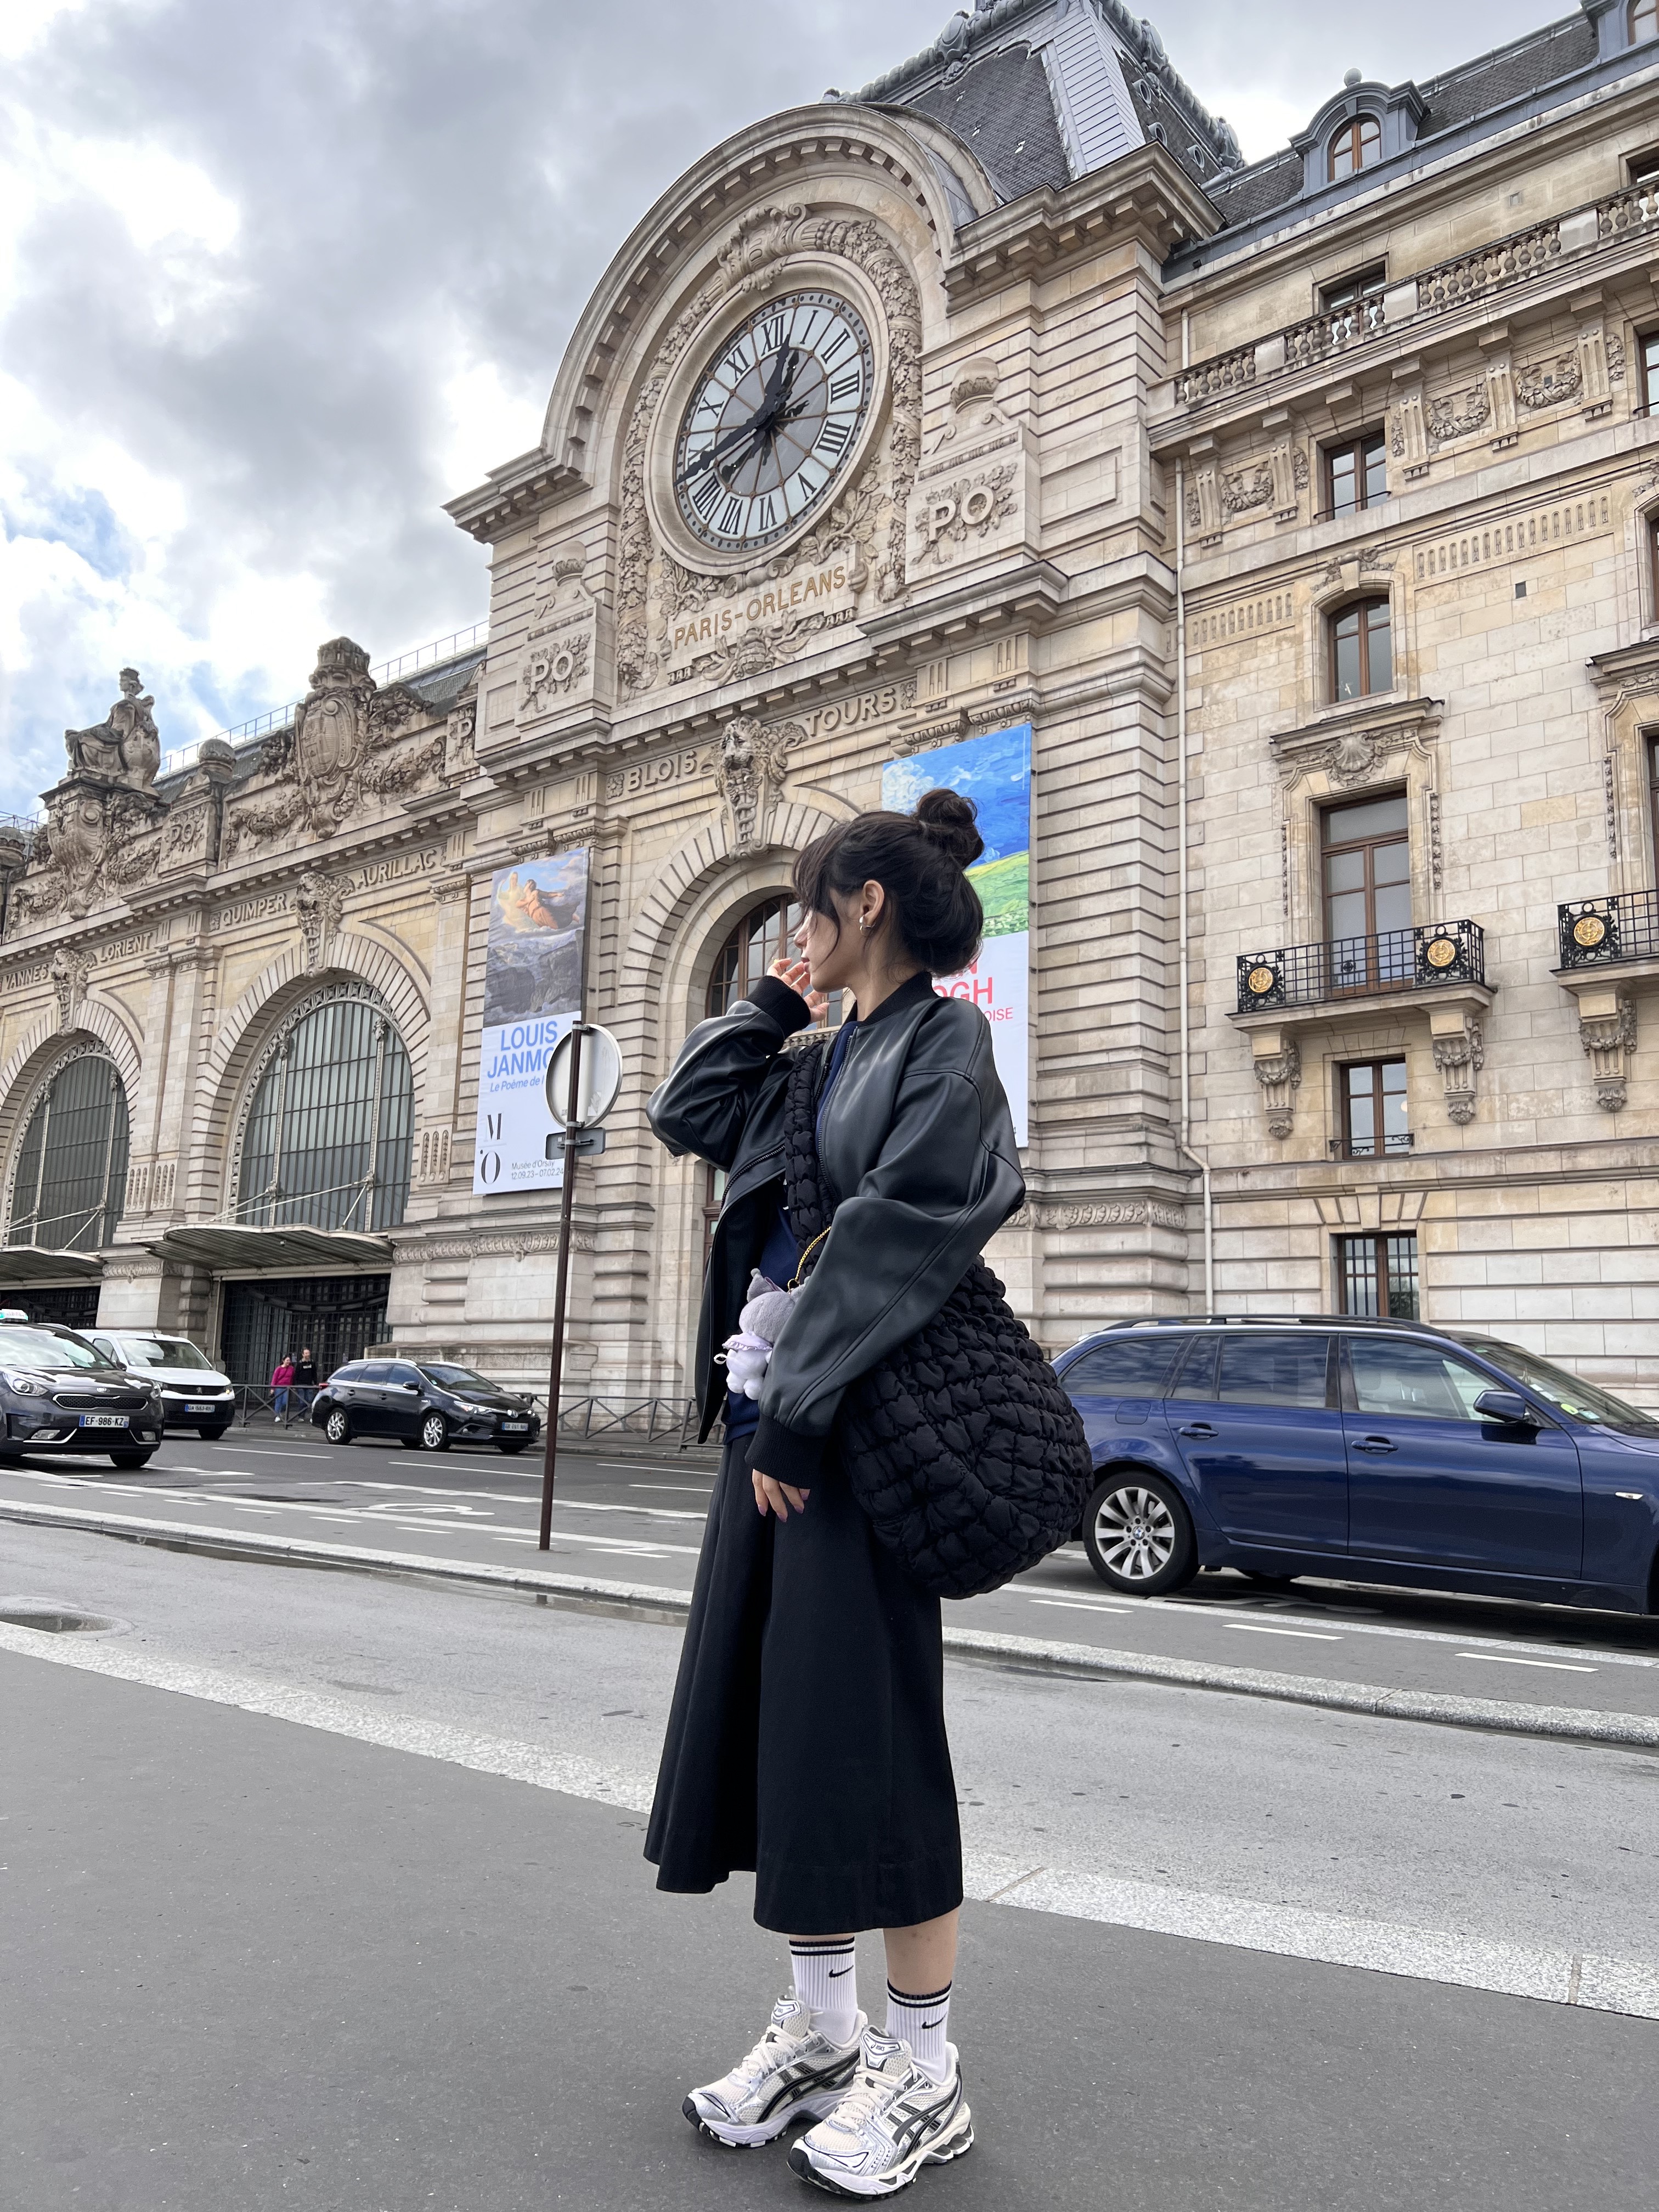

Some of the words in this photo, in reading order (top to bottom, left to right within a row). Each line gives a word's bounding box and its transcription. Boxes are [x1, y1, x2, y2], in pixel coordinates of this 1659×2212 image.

[761, 313, 786, 357] XII
[821, 328, 850, 364] II
[724, 345, 751, 383] XI
[831, 370, 859, 404] III
[697, 397, 724, 418] X
[815, 420, 851, 456] IIII
[692, 472, 723, 521] VIII
[798, 472, 817, 501] V
[718, 496, 743, 535] VII
[758, 495, 778, 532] VI
[929, 486, 994, 543] PO
[674, 566, 845, 650] PARIS-ORLEANS
[531, 650, 574, 693] PO
[805, 687, 896, 737] TOURS
[456, 717, 472, 748] P
[628, 751, 697, 792] BLOIS
[357, 849, 437, 889] AURILLAC
[222, 893, 286, 926] QUIMPER
[100, 932, 152, 962] LORIENT
[6, 963, 49, 989] VANNES
[501, 1020, 557, 1051] LOUIS
[490, 1082, 500, 1092] Le
[501, 1079, 528, 1091] Poème
[530, 1075, 540, 1086] de
[511, 1161, 531, 1170] Musée
[86, 1417, 124, 1426] EF-986-KZ
